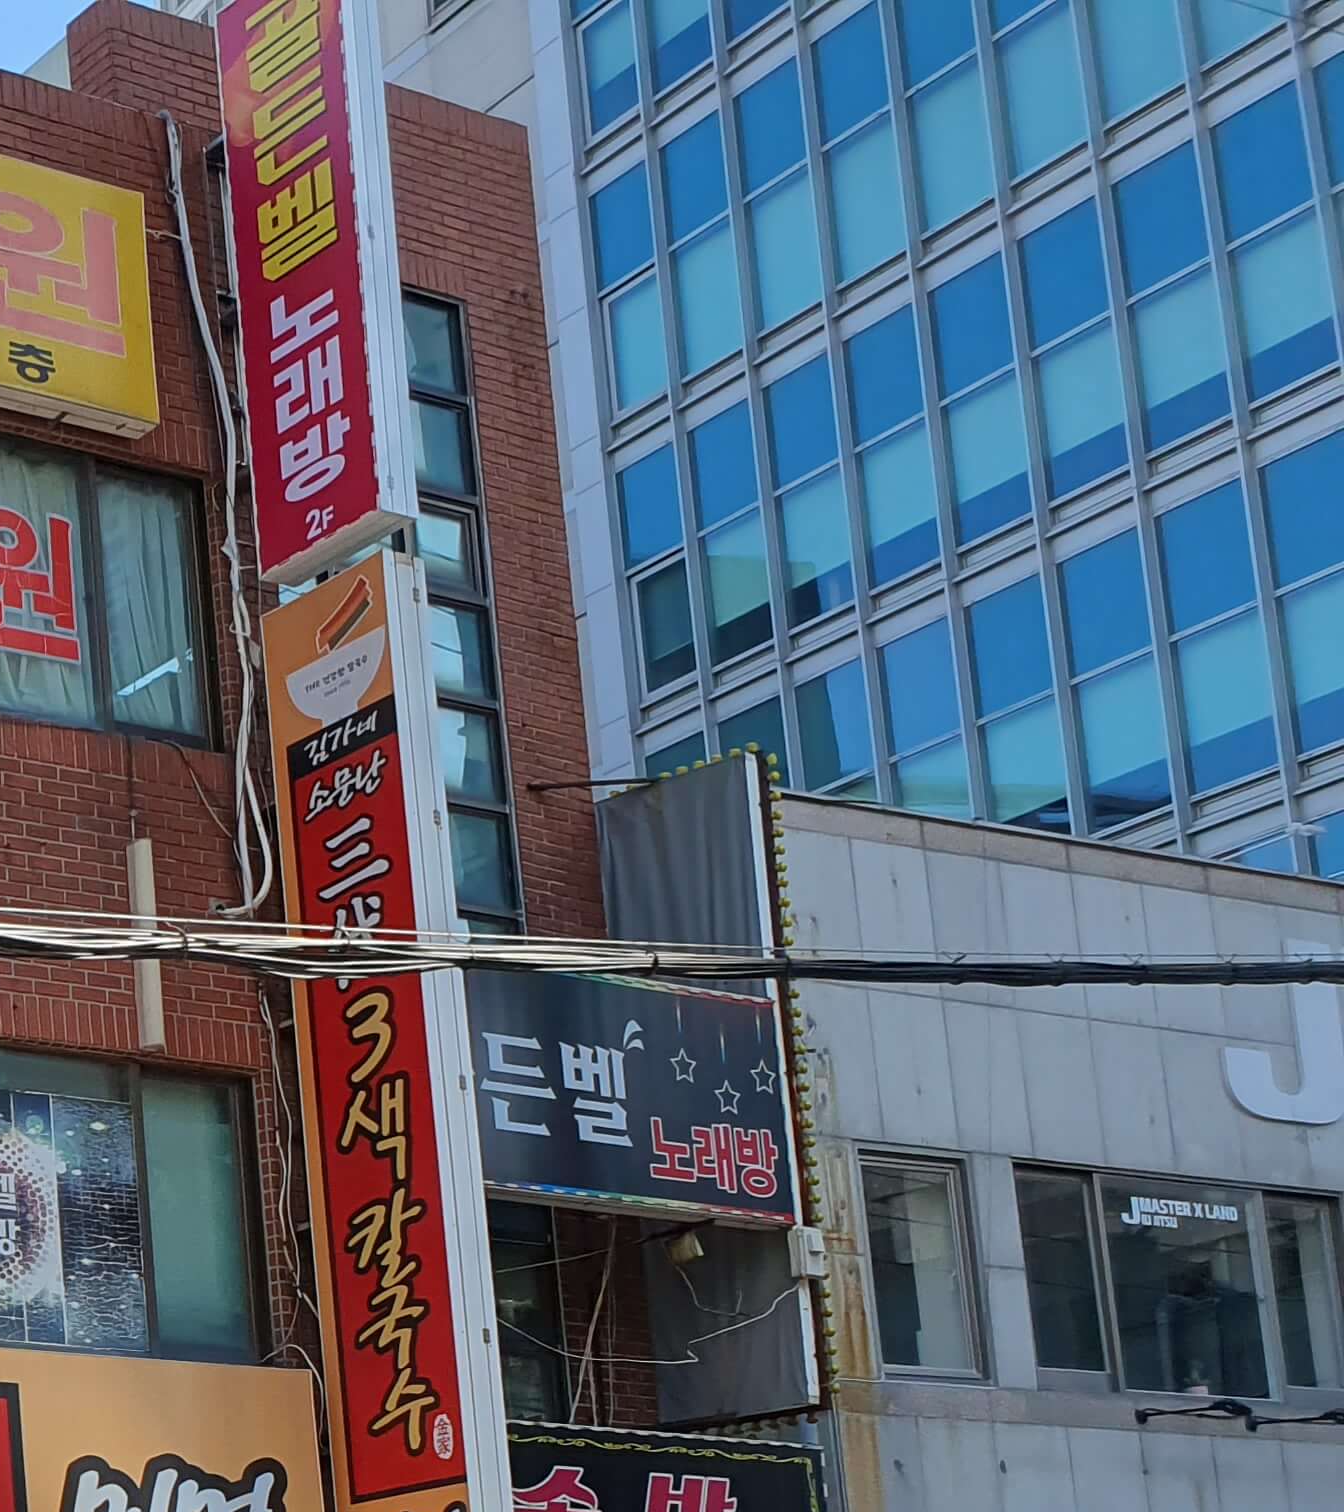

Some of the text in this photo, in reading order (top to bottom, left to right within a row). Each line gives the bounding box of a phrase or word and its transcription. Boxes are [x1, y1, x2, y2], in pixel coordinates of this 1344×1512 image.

[244, 0, 342, 283] 골든벨
[268, 288, 352, 504] 노래방
[304, 503, 337, 542] 2F
[303, 709, 379, 767] 김가네
[304, 749, 388, 825] 소문난
[649, 1115, 779, 1199] 노래방
[340, 991, 438, 1454] 3색칼국수
